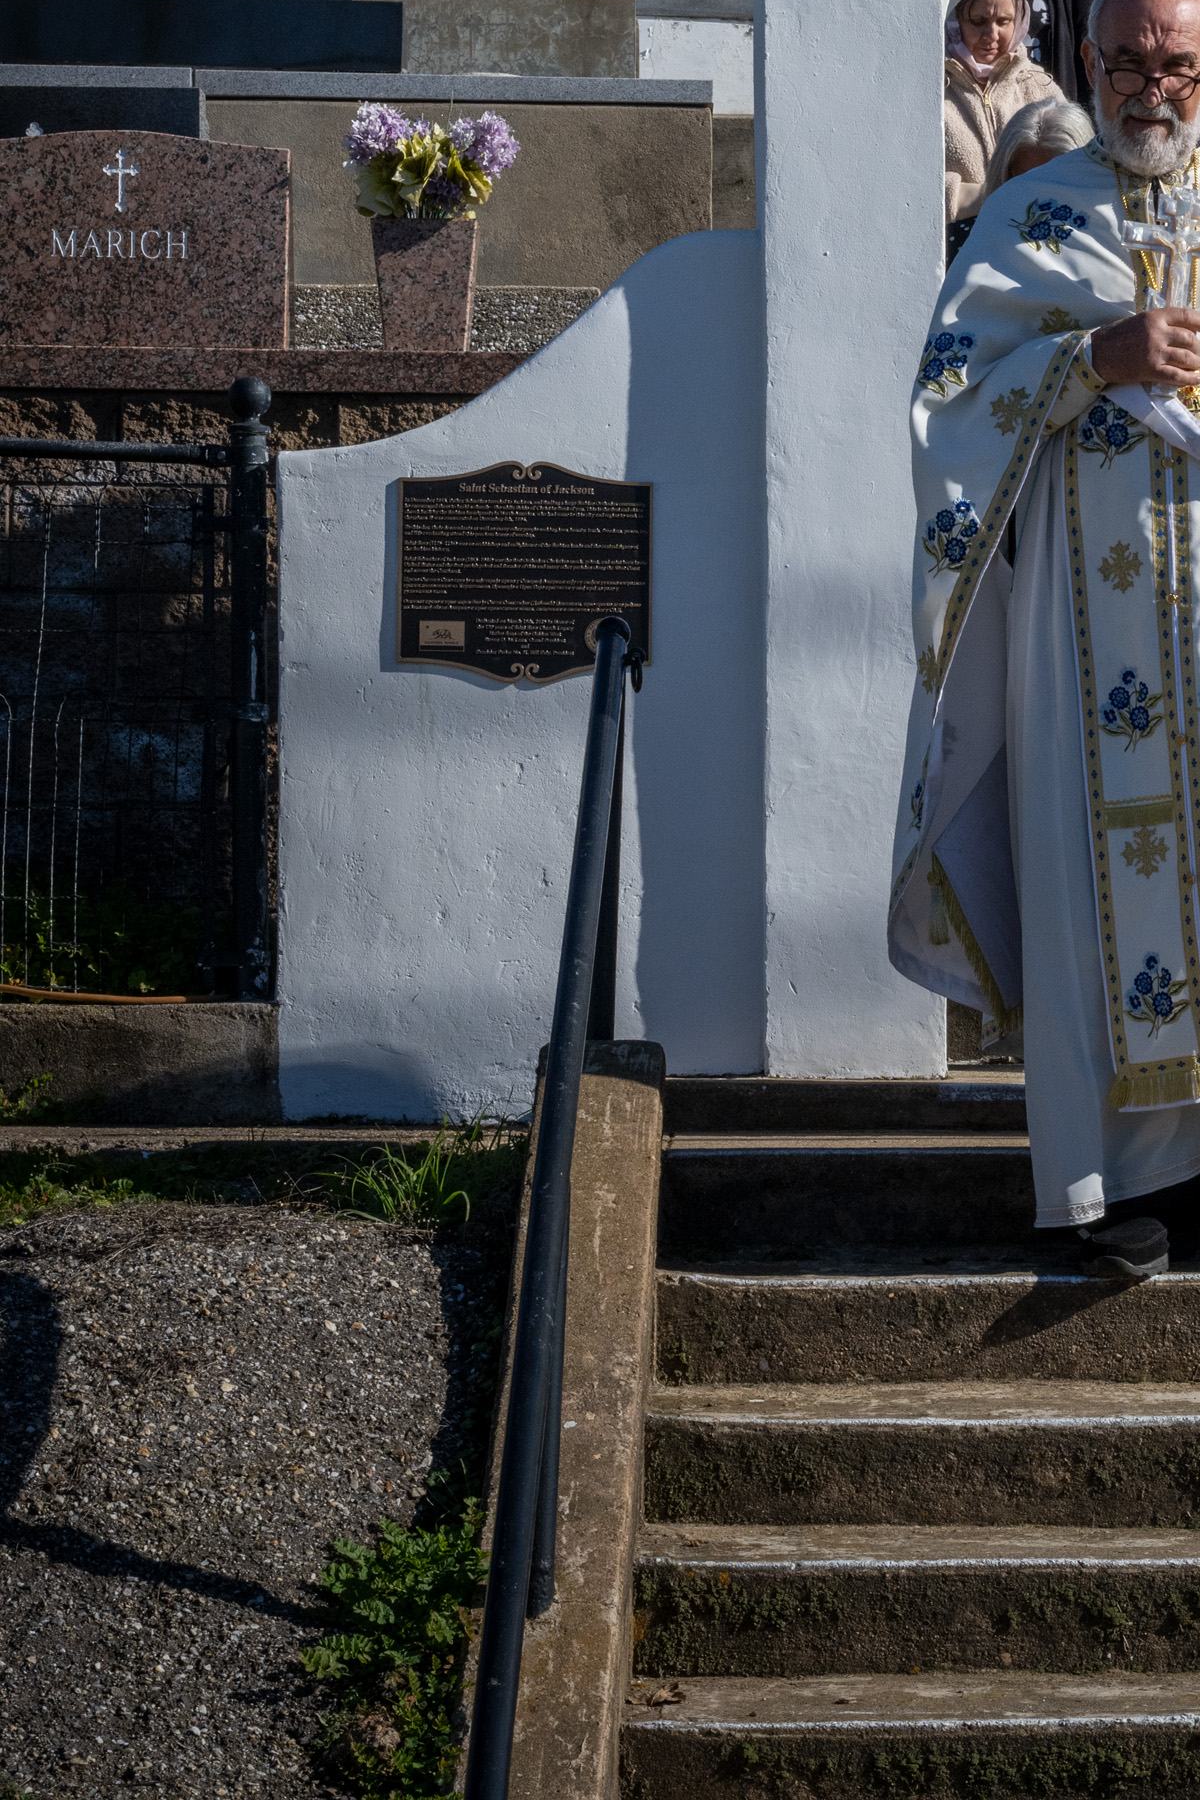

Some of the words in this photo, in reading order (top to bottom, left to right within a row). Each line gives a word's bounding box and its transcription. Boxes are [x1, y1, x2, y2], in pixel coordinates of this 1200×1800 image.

[50, 228, 189, 259] MARICH
[459, 482, 487, 493] Saint
[488, 482, 538, 494] Sebastian
[540, 484, 552, 494] of
[553, 485, 595, 495] Jackson
